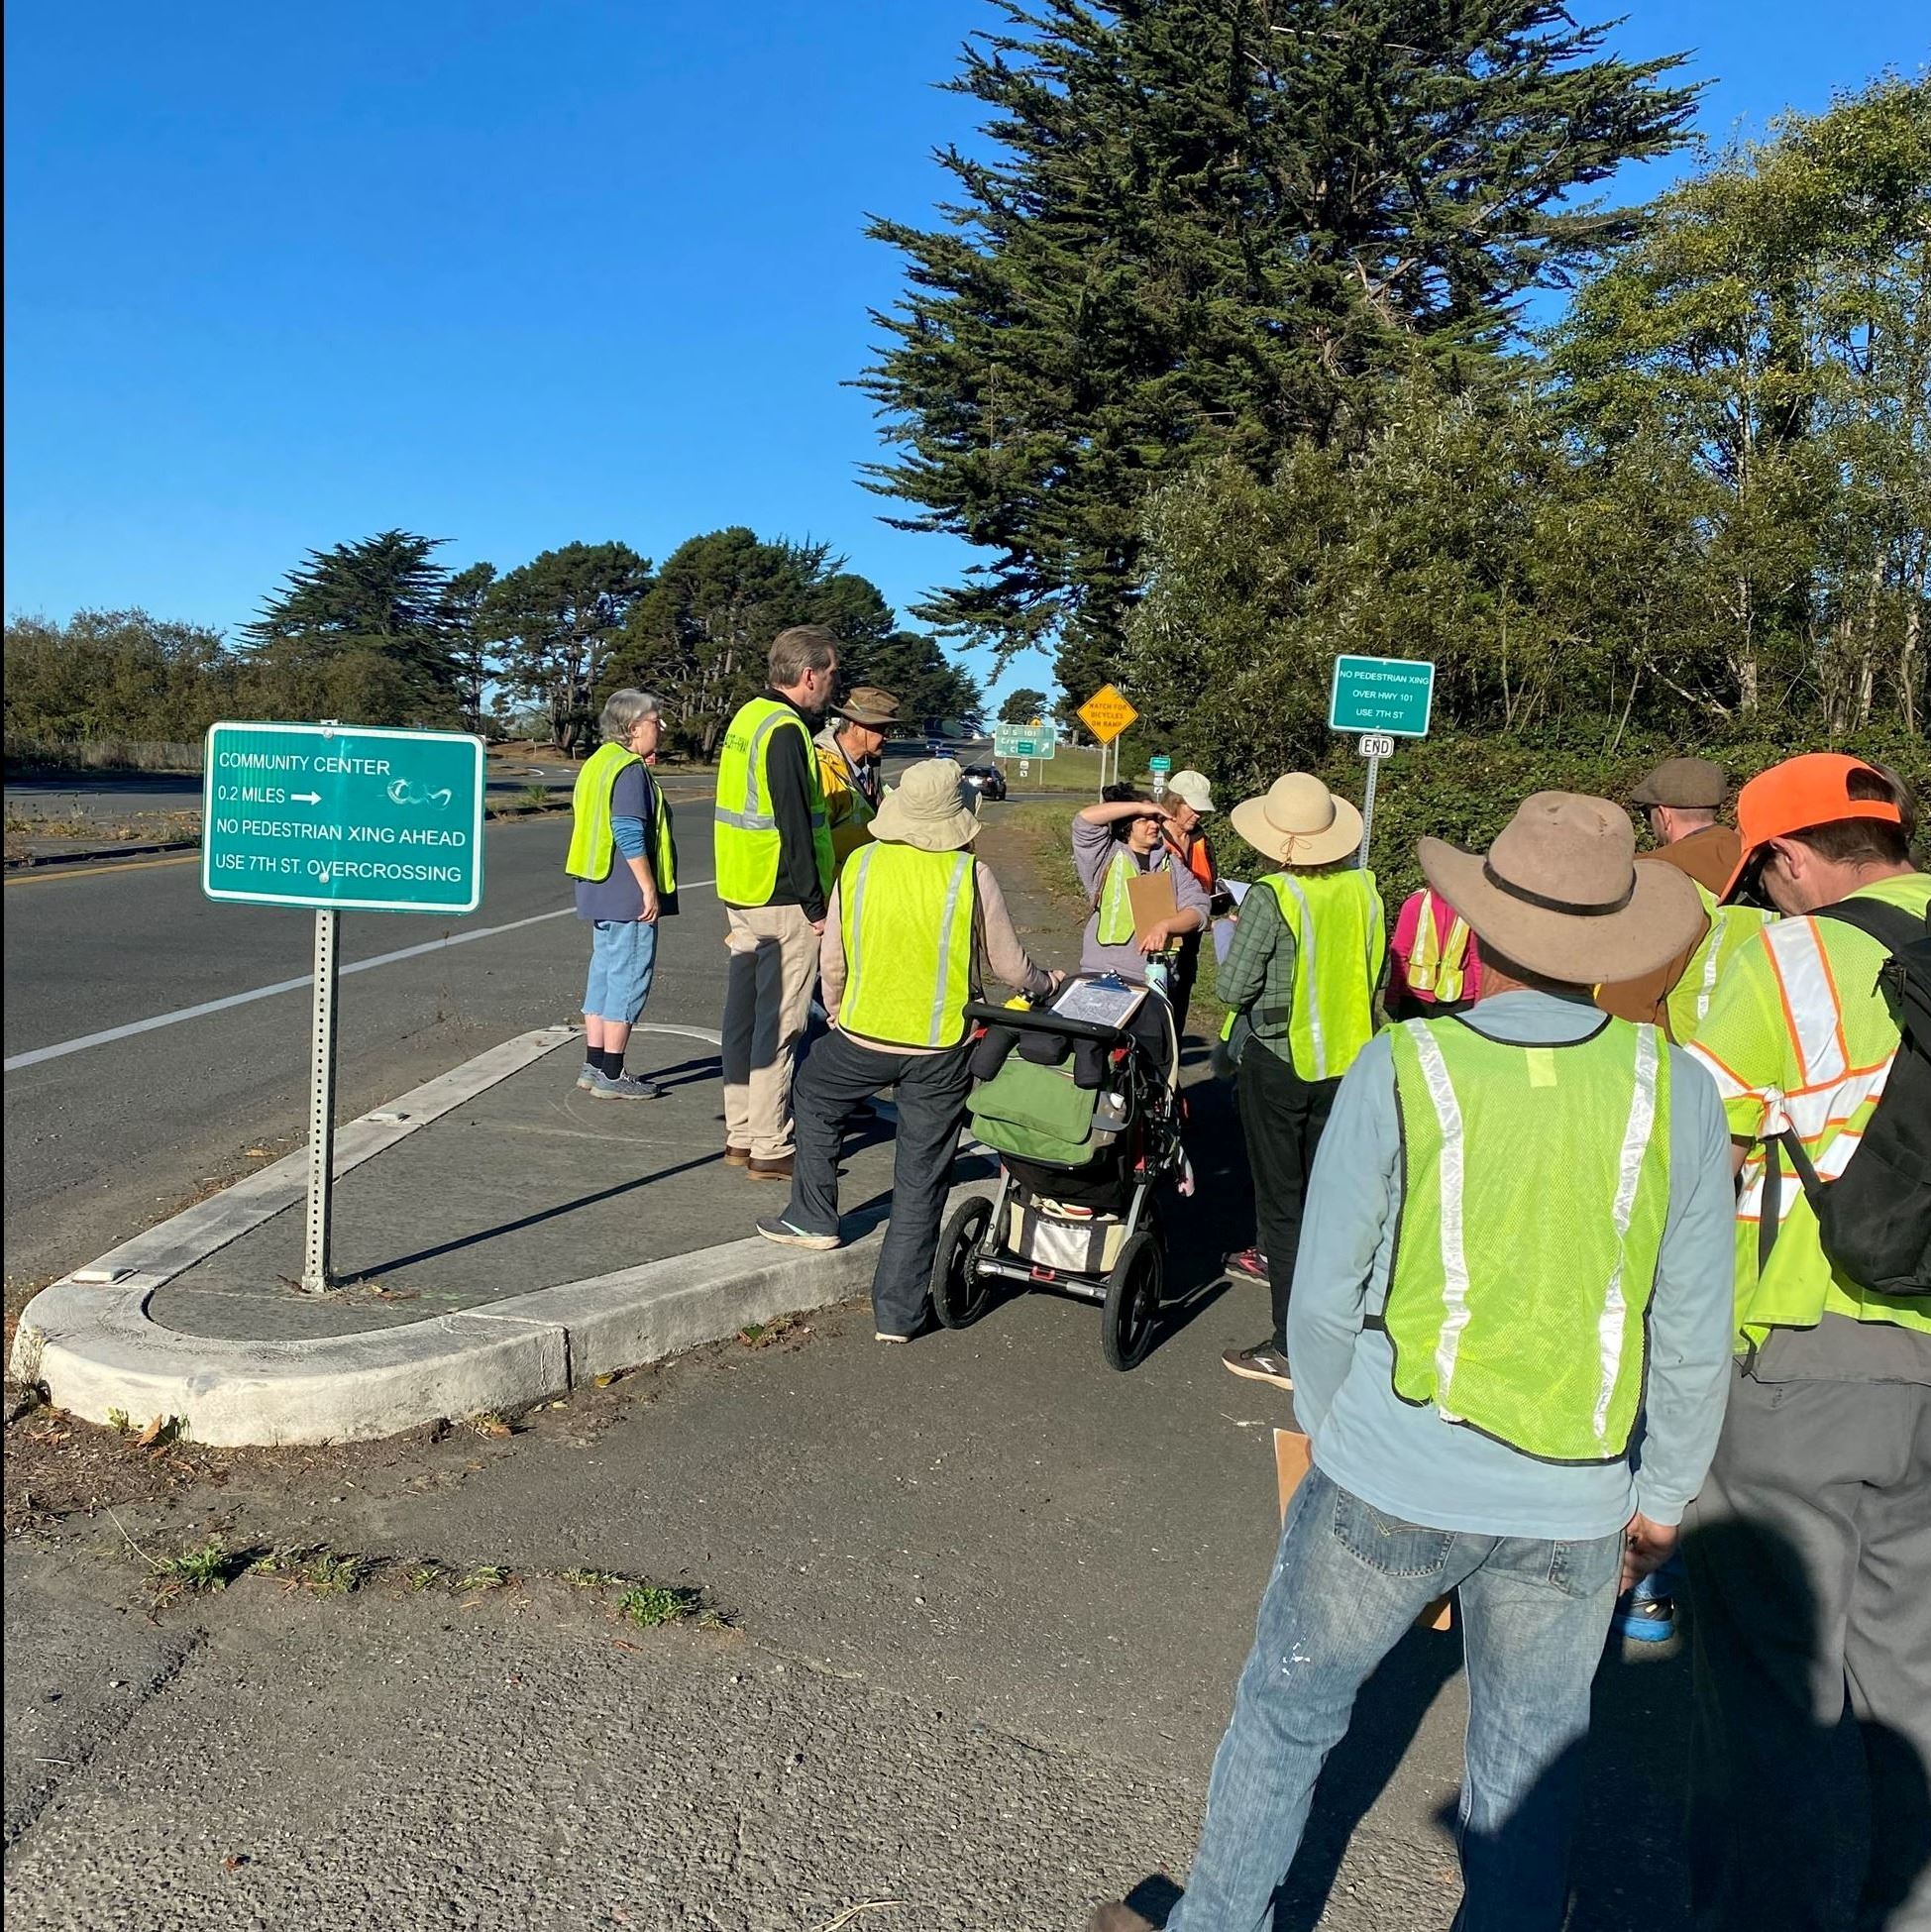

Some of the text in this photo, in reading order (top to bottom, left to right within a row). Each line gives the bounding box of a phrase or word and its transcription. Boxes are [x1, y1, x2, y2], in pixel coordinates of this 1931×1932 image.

[1340, 670, 1430, 685] NO PEDESTRIAN XING
[1352, 690, 1414, 702] OVER HWY 101
[1355, 708, 1405, 719] USE 7TH ST
[1364, 739, 1389, 754] END
[219, 752, 390, 776] COMMUNITY CENTER
[218, 785, 285, 804] 0.2 MILES
[217, 818, 466, 847] NO PEDESTRIAN XING AHEAD
[215, 853, 462, 883] USE 7TH ST. OVERCROSSING
